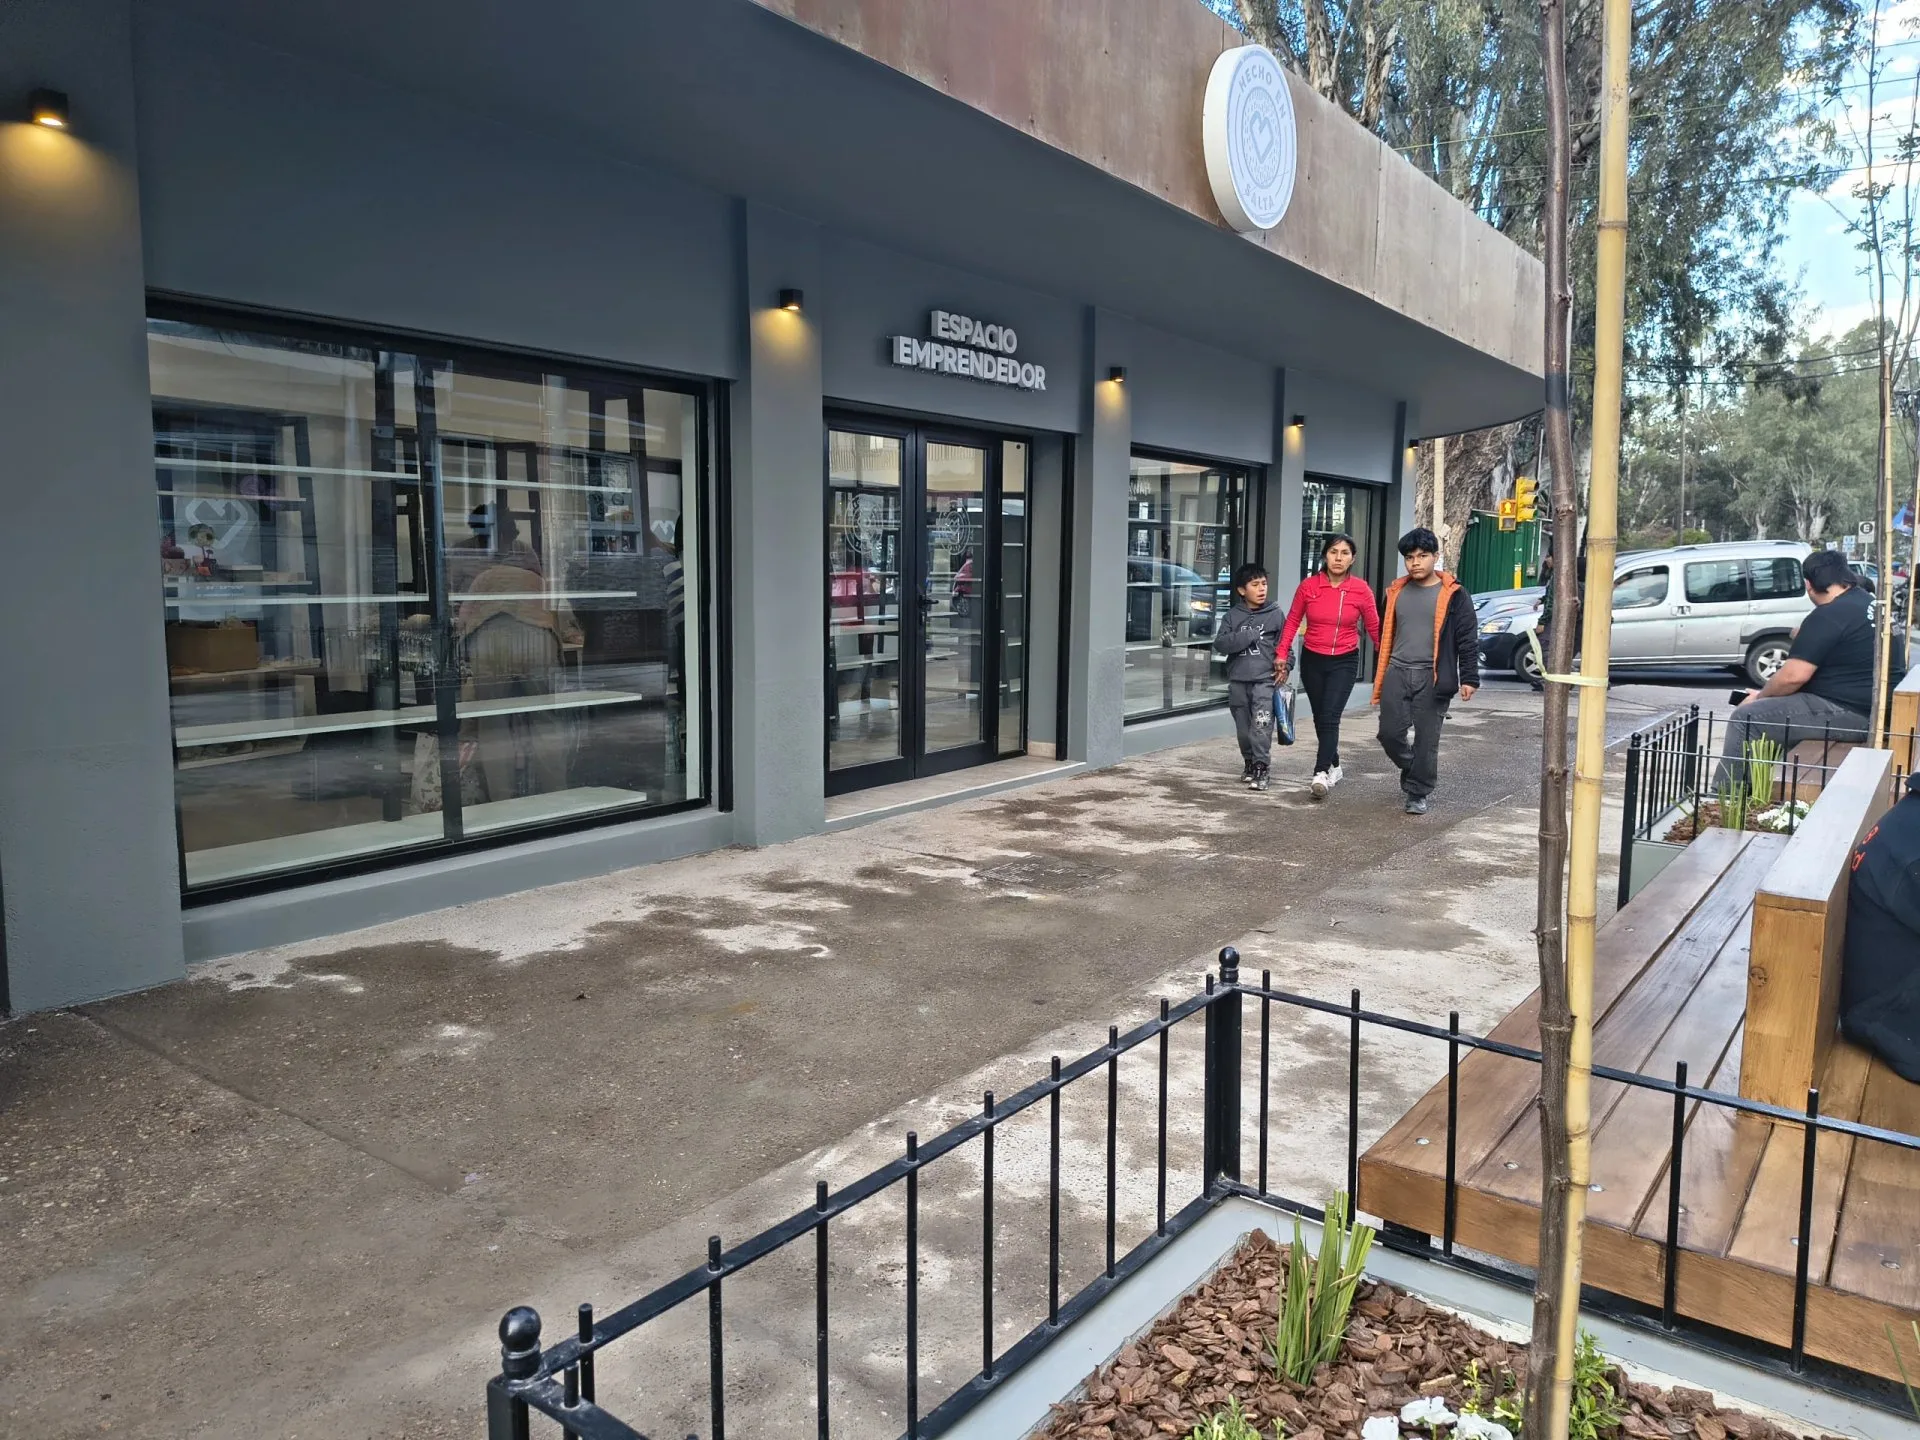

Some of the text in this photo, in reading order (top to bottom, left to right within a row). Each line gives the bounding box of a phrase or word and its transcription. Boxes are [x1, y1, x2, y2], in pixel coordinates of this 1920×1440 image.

[1238, 64, 1286, 119] HECHO EN
[1244, 183, 1275, 211] SALTA
[932, 310, 1018, 354] ESPACIO
[894, 336, 1047, 390] EMPRENDEDOR
[1863, 523, 1870, 533] E
